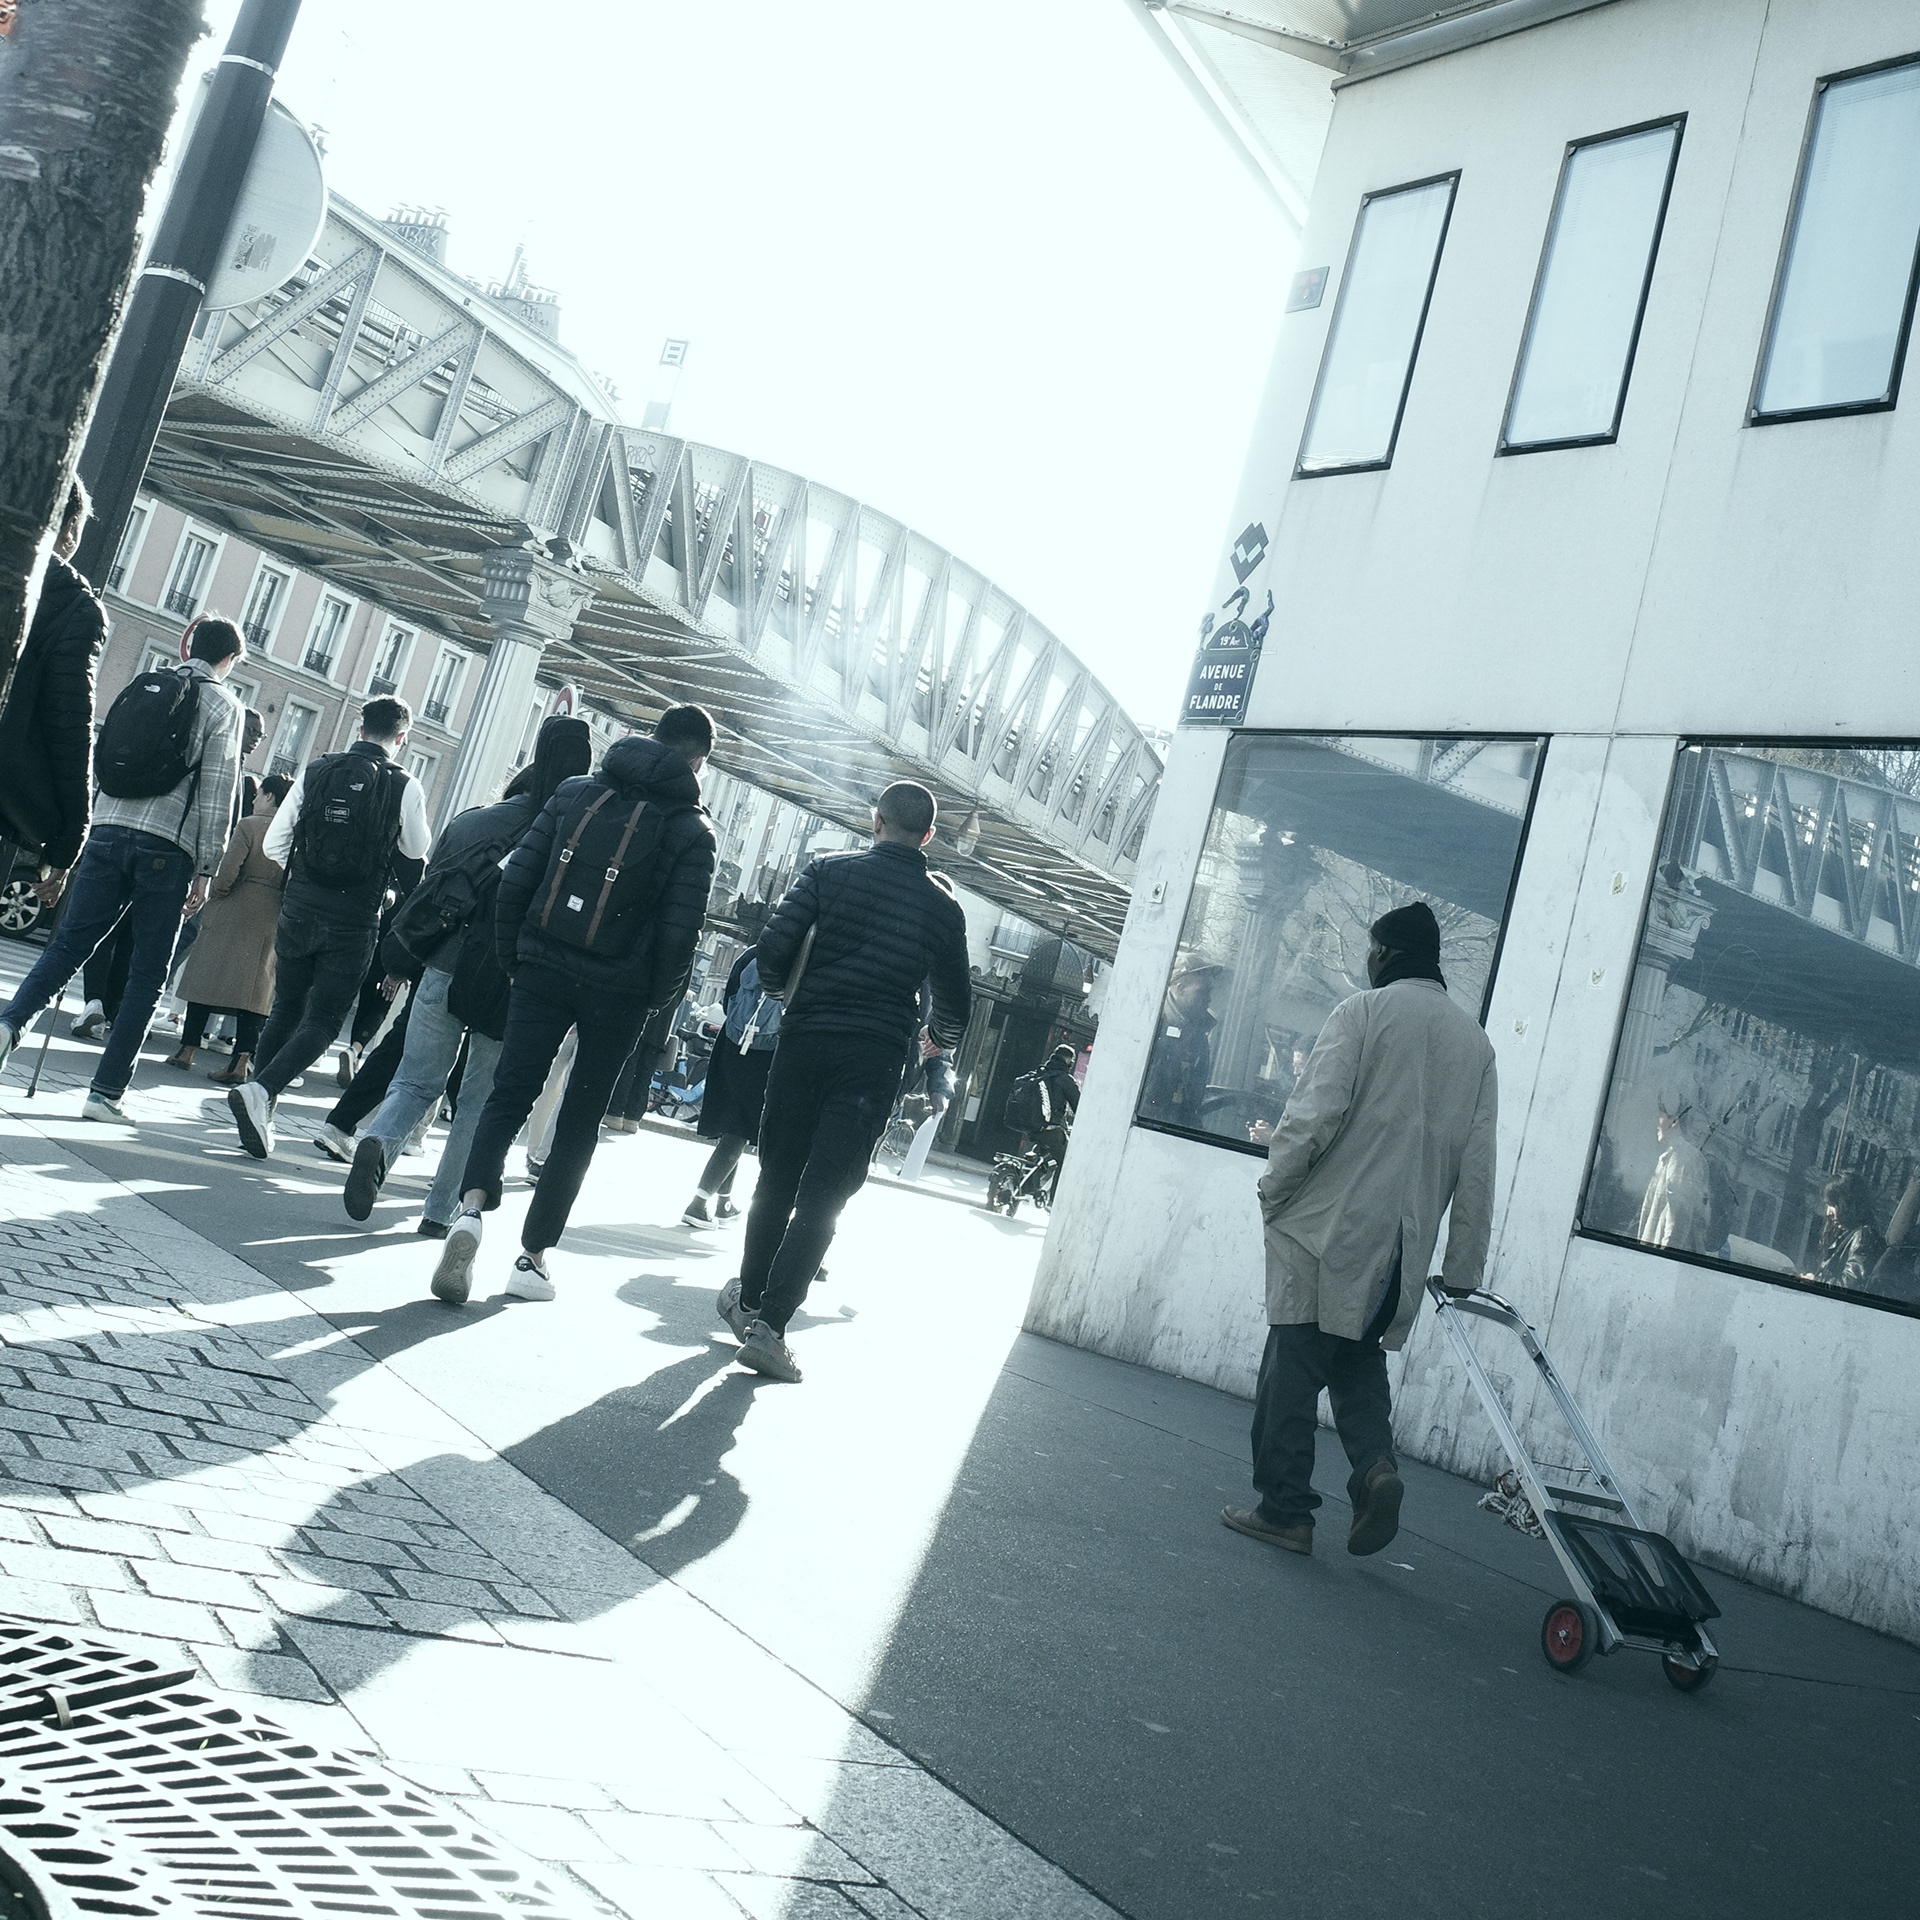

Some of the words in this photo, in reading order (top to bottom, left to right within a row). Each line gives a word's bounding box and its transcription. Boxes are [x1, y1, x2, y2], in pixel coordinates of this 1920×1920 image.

[1199, 664, 1246, 680] AVENUE
[1213, 682, 1224, 691] DE
[1189, 694, 1241, 710] FLANDRE
